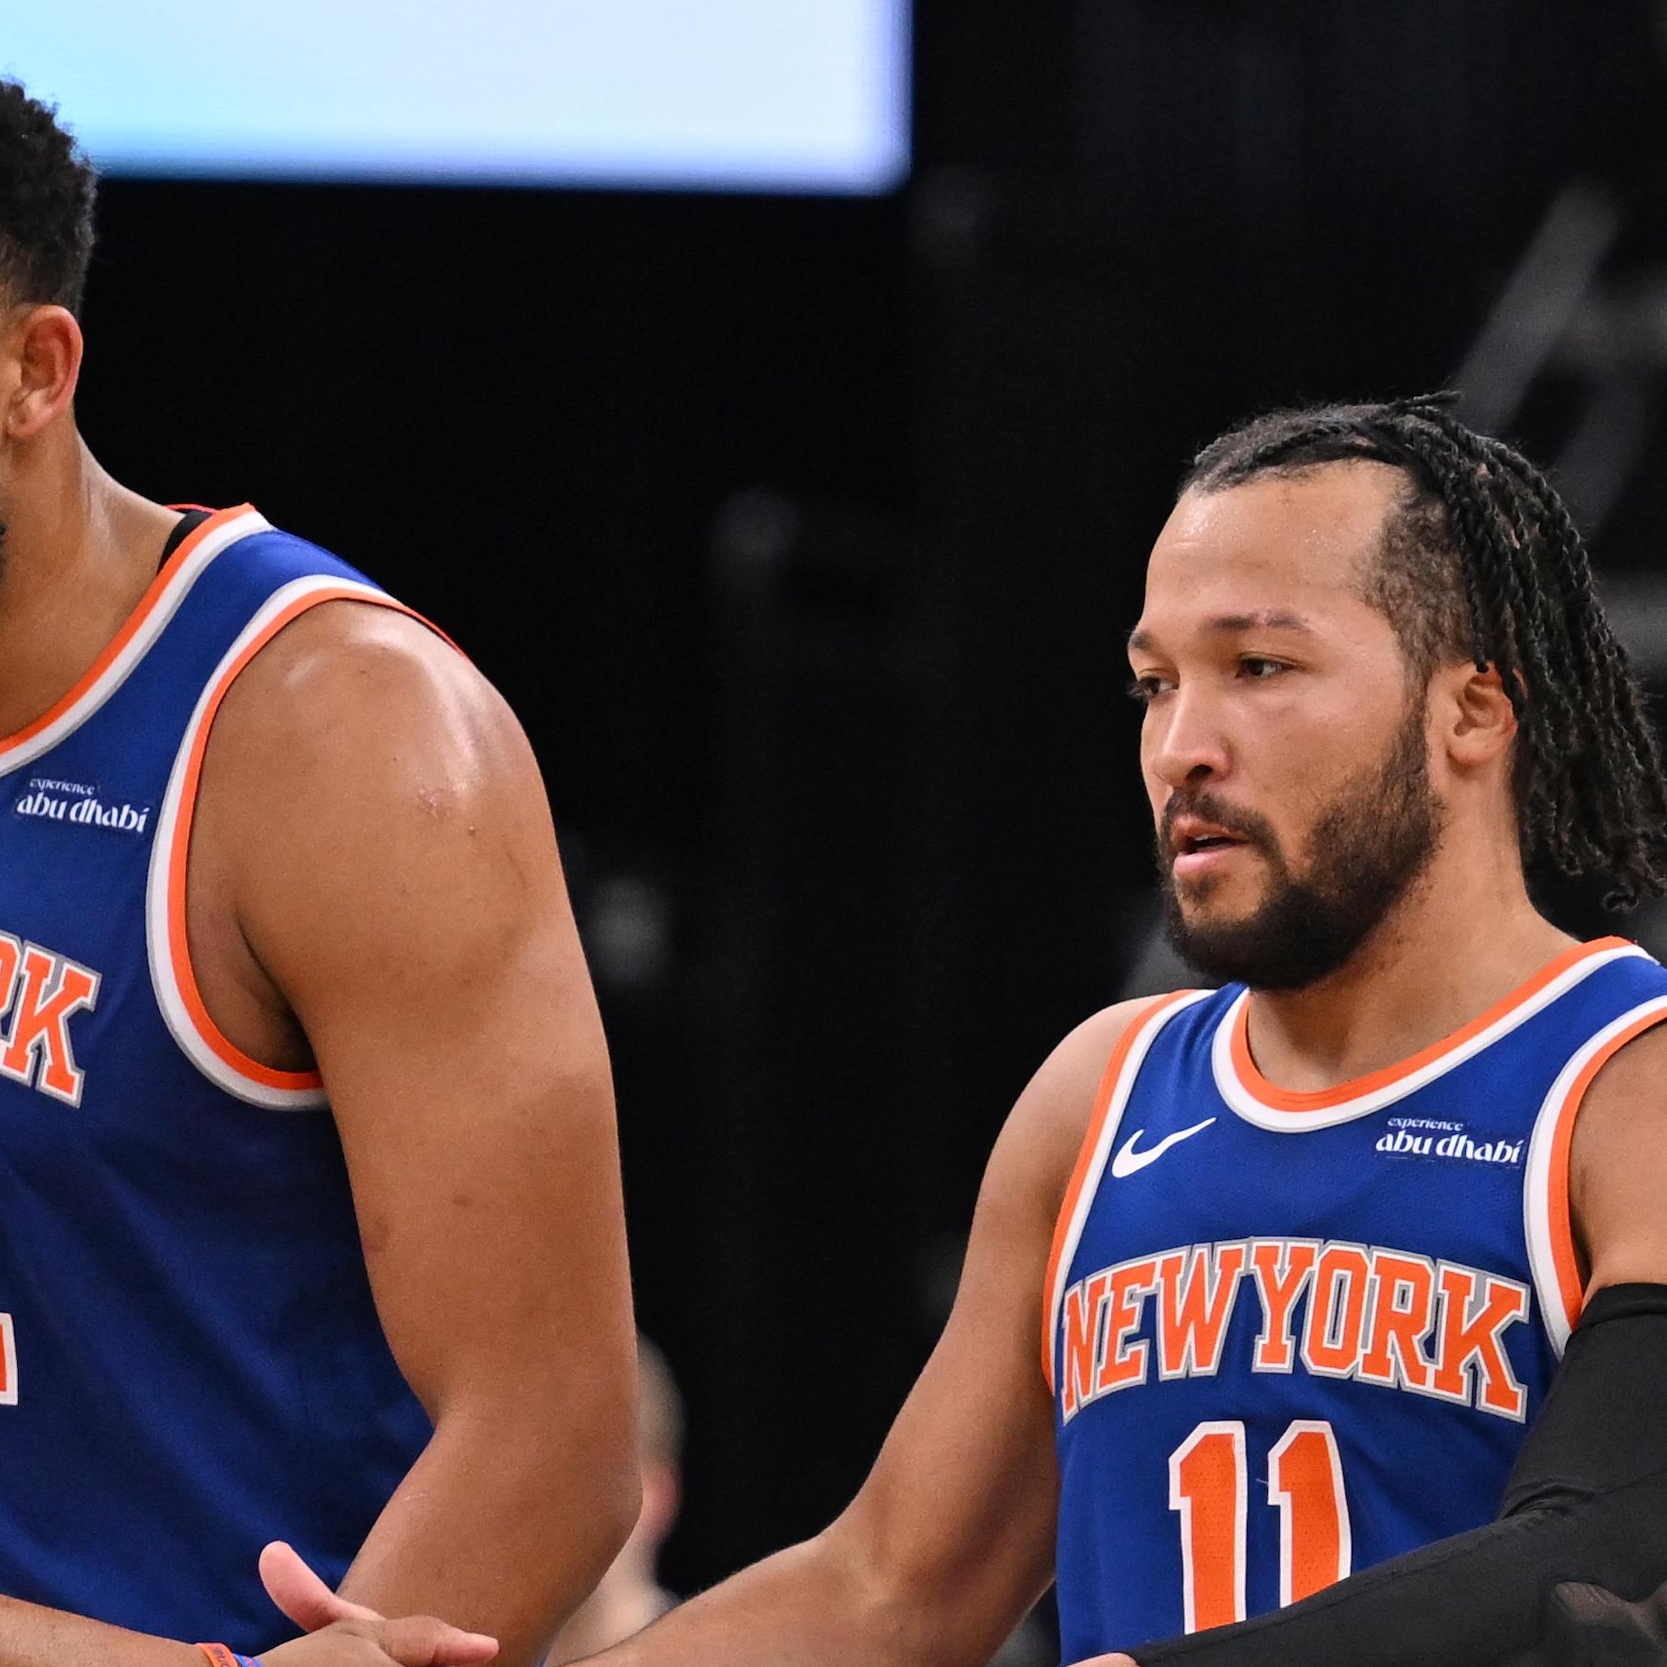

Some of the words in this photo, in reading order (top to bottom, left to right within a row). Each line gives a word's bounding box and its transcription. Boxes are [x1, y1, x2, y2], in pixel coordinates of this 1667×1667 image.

[29, 778, 95, 795] experience
[17, 792, 67, 820] abu
[69, 798, 150, 833] dhabi
[1387, 1117, 1464, 1131] experience
[1376, 1130, 1433, 1155] abu
[1436, 1134, 1524, 1163] dhabi
[1062, 1241, 1244, 1426] NEW
[1249, 1236, 1531, 1424] YORK
[1169, 1419, 1352, 1635] 11
